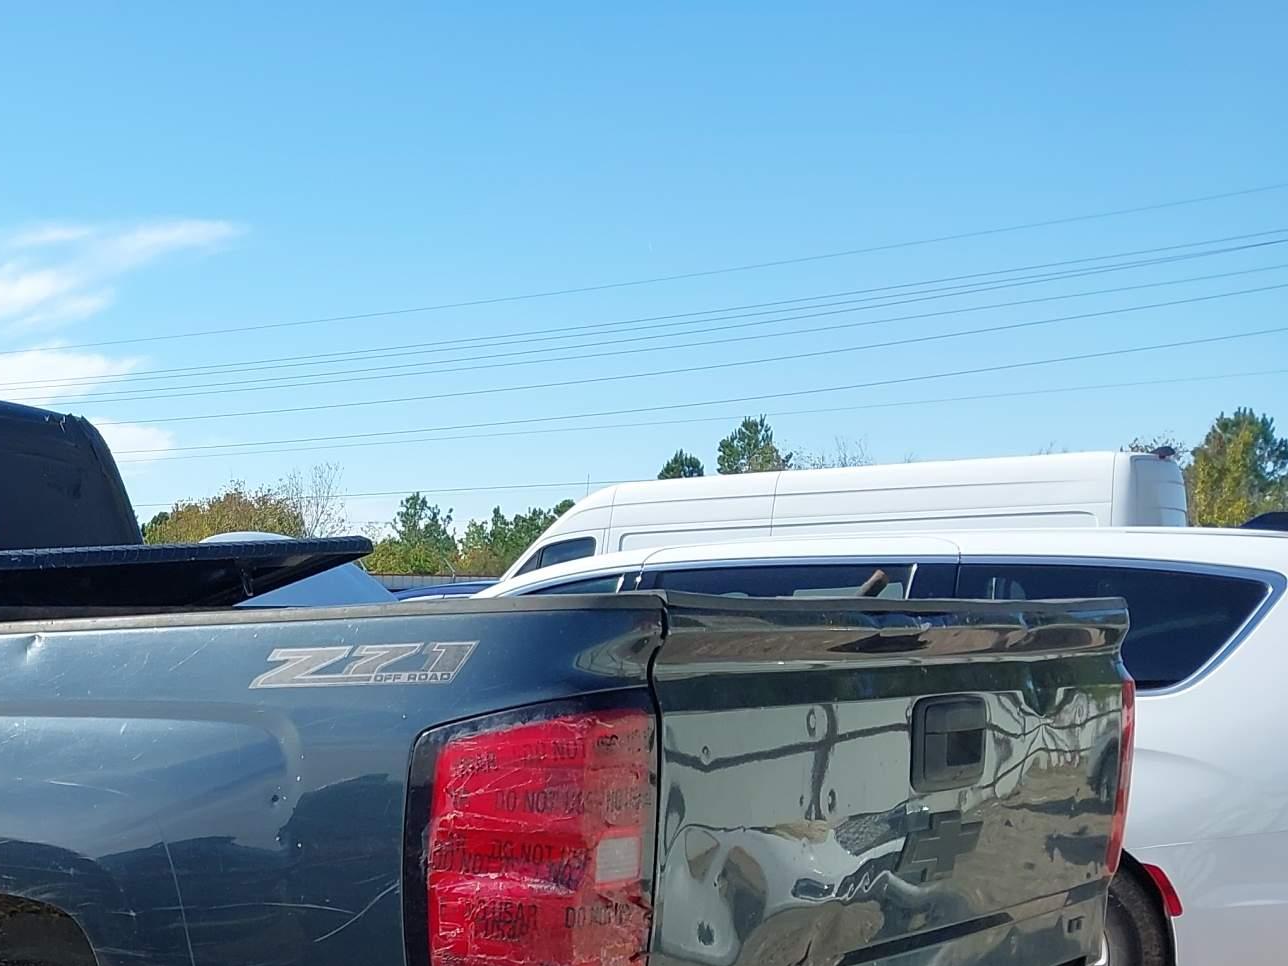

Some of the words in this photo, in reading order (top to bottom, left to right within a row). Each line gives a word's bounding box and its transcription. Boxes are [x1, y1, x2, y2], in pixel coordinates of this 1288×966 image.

[249, 640, 479, 689] Z71
[373, 672, 402, 683] OFF
[407, 672, 451, 682] ROAD
